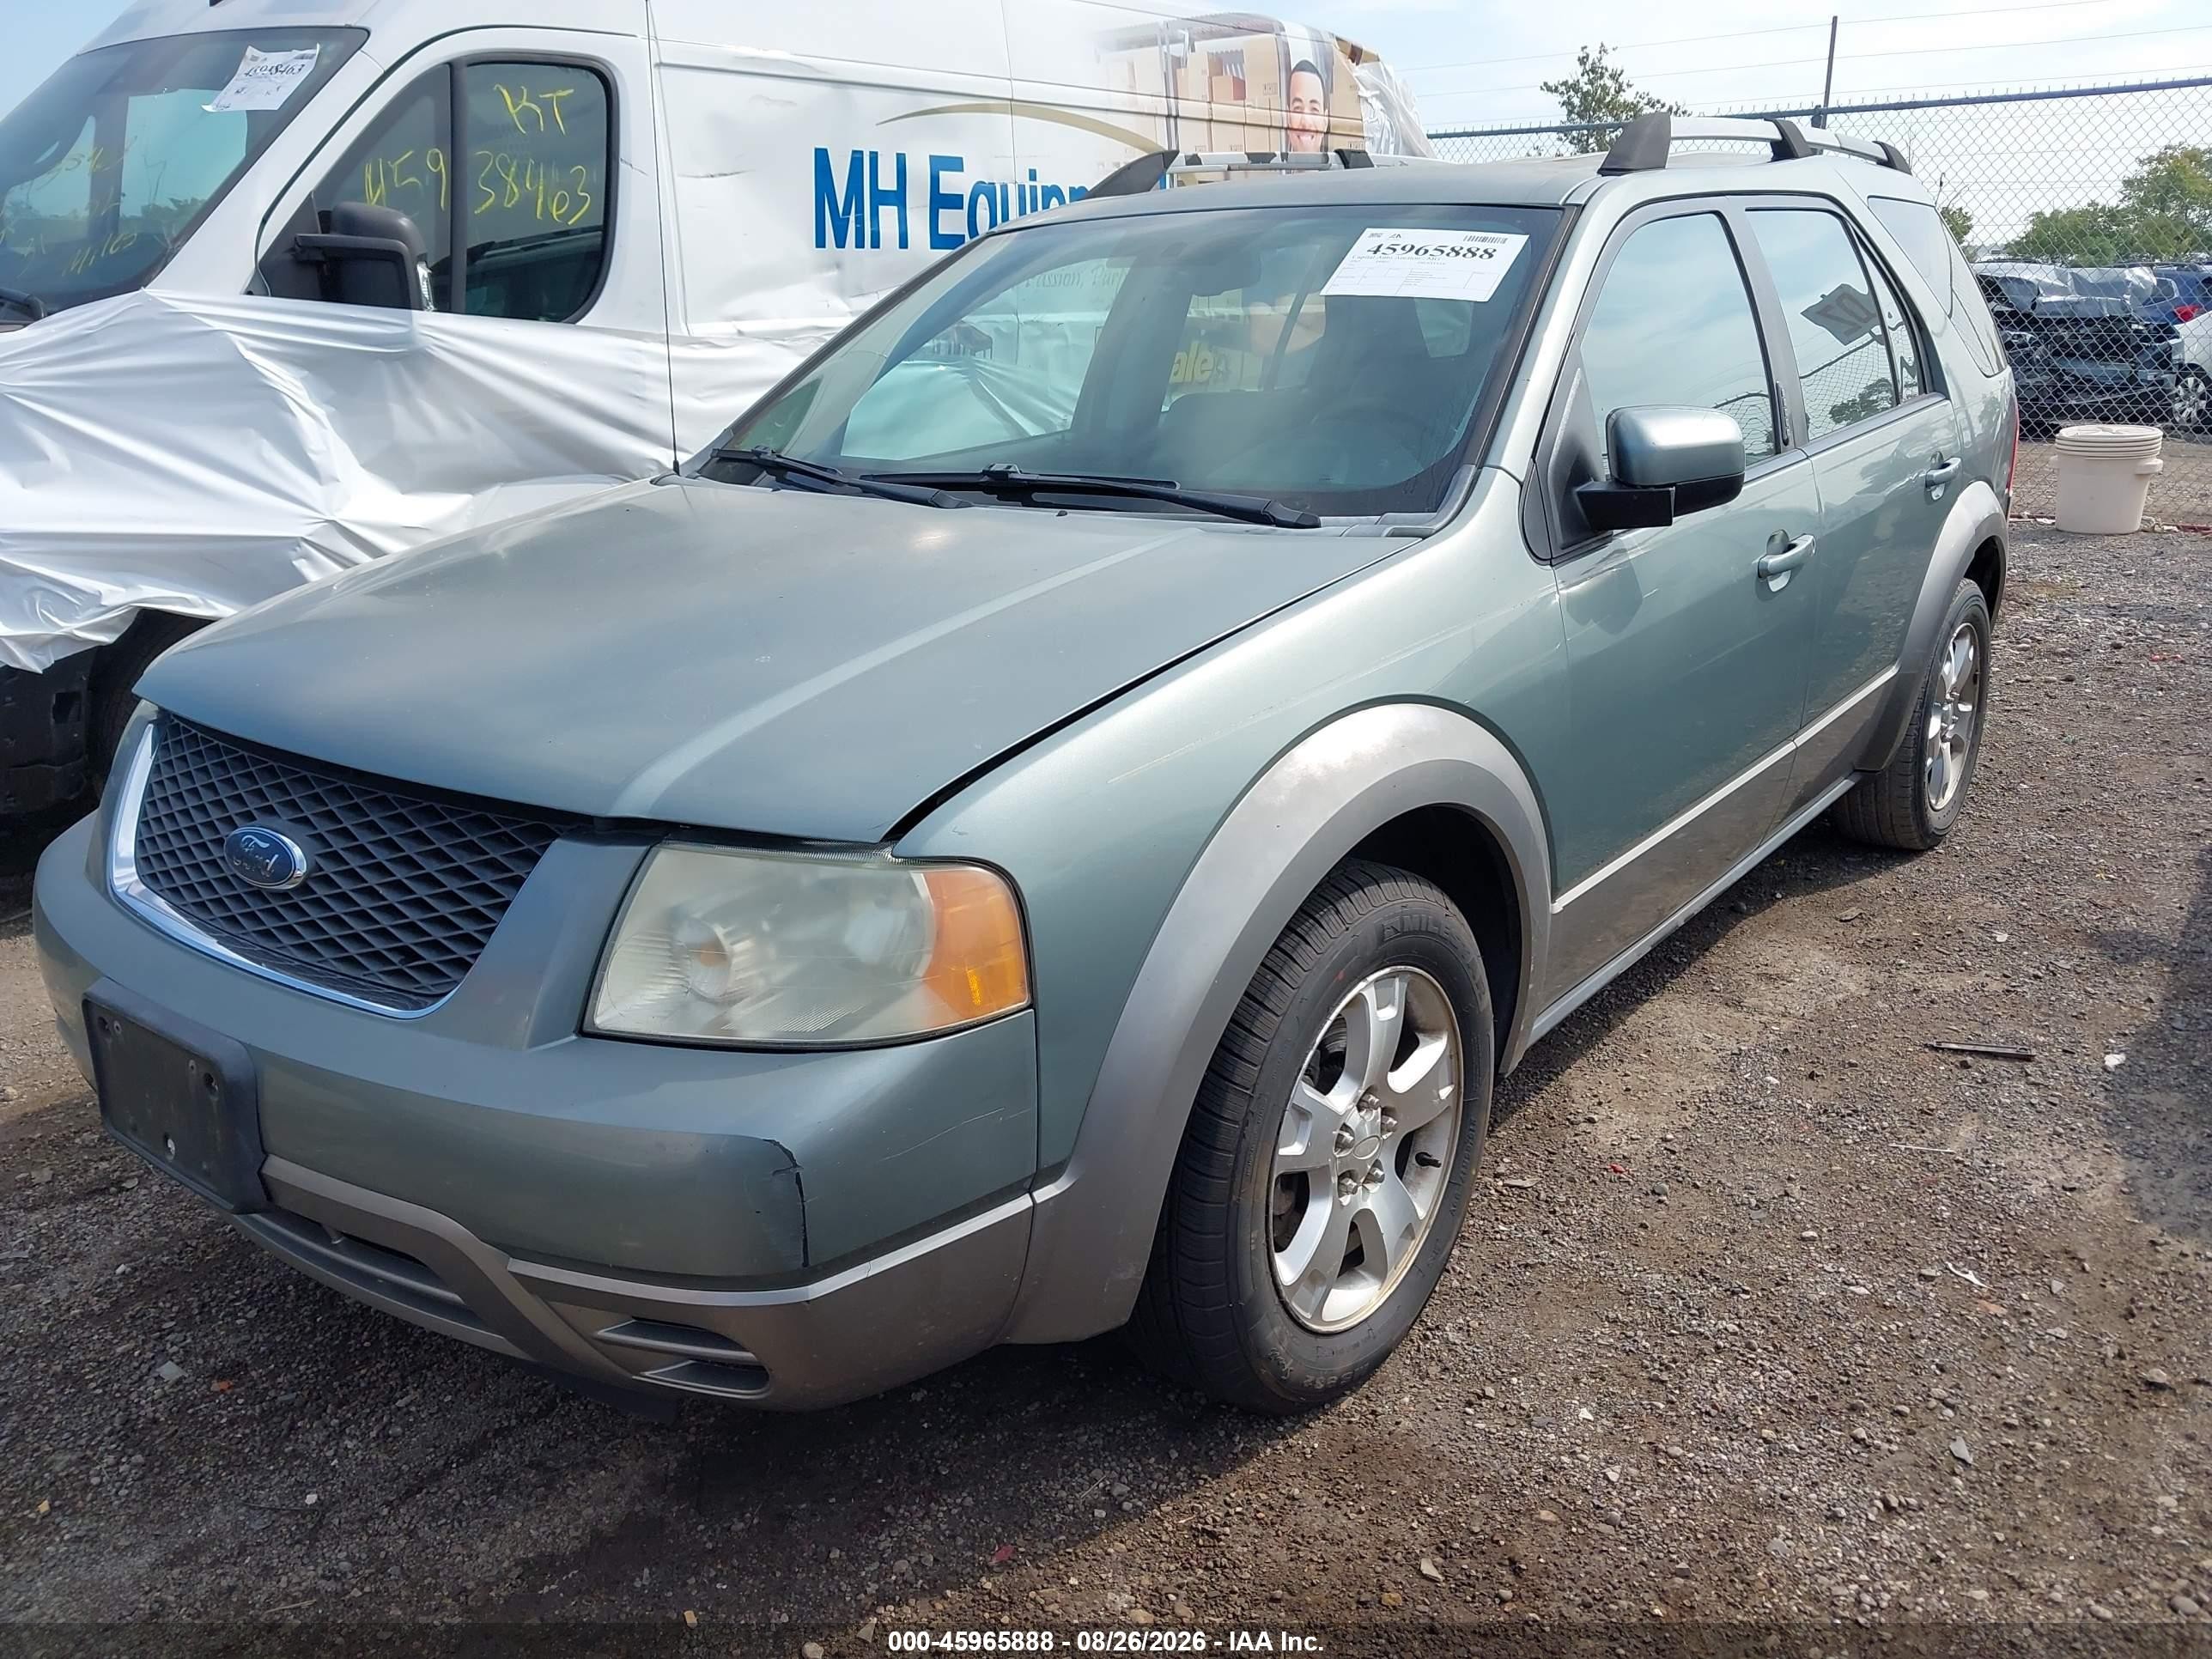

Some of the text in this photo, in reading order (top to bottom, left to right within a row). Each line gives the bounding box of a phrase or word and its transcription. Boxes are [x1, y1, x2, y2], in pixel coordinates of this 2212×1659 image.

[494, 83, 574, 135] KT
[813, 147, 909, 250] MH
[1367, 243, 1498, 260] 45965888
[1169, 341, 1215, 385] ale
[233, 835, 280, 878] Ford
